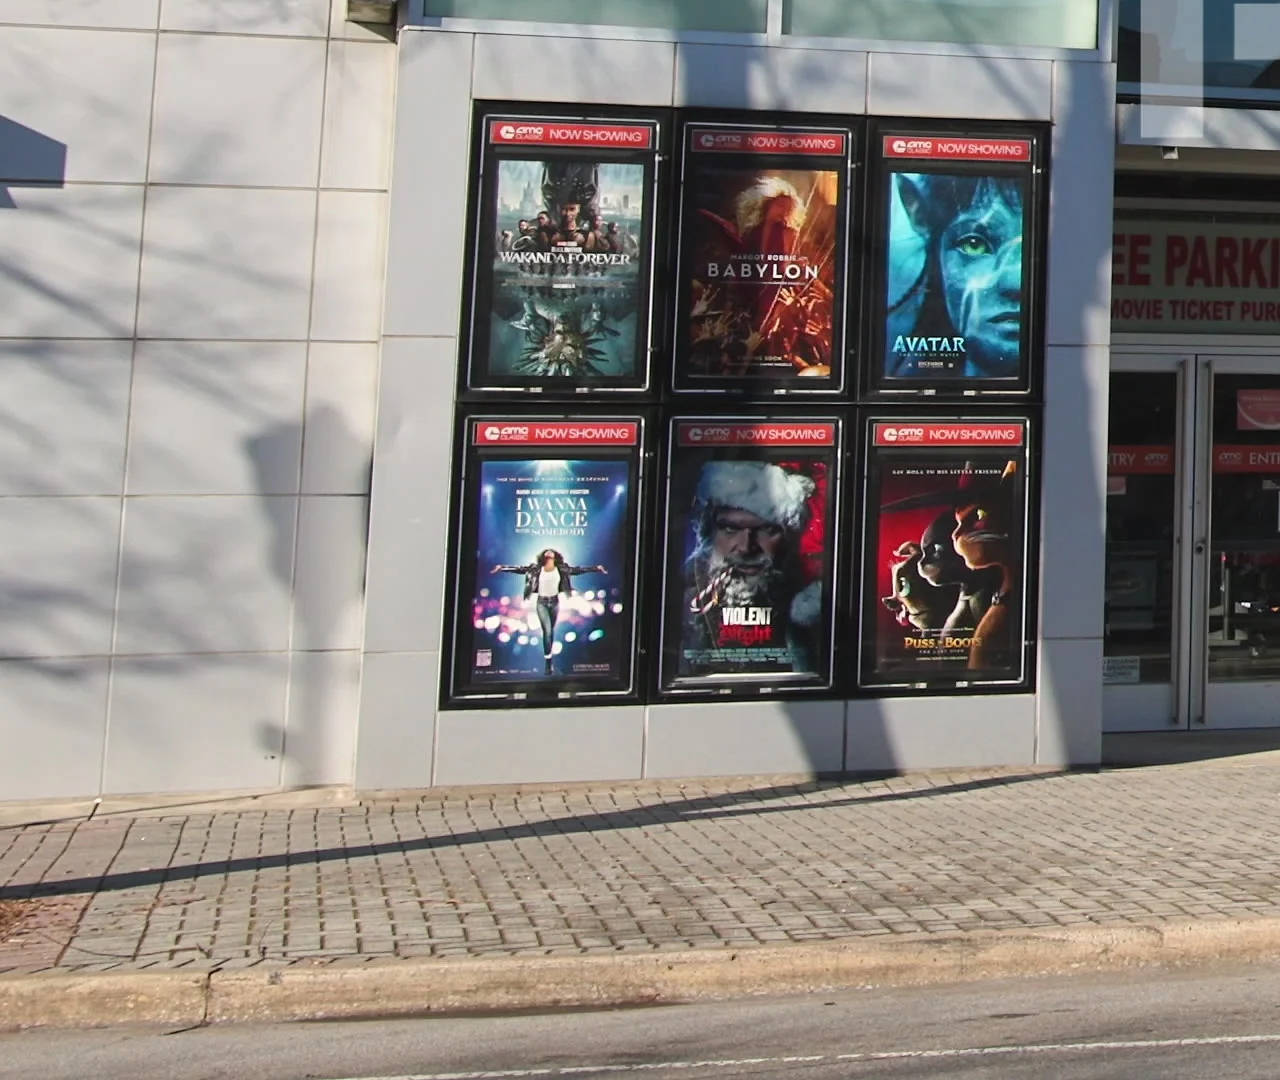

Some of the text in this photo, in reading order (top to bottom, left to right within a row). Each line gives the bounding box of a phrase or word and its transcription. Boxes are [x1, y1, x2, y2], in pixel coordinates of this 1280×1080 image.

[550, 130, 642, 141] NOW SHOWING
[748, 137, 835, 149] NOW SHOWING
[938, 143, 1022, 155] NOW SHOWING
[500, 251, 631, 265] WAKANDA FOREVER
[707, 262, 819, 279] BABYLON
[1169, 300, 1235, 320] TICKET
[892, 335, 966, 353] AVATAR
[535, 428, 629, 439] NOW SHOWING
[736, 429, 826, 440] NOW SHOWING
[929, 429, 1015, 440] NOW SHOWING
[516, 498, 587, 510] I WANNA
[516, 511, 588, 528] DANCE
[531, 527, 585, 536] SOMEBODY
[722, 607, 773, 626] VIOLENT
[904, 636, 982, 648] PUSS BOOTS
